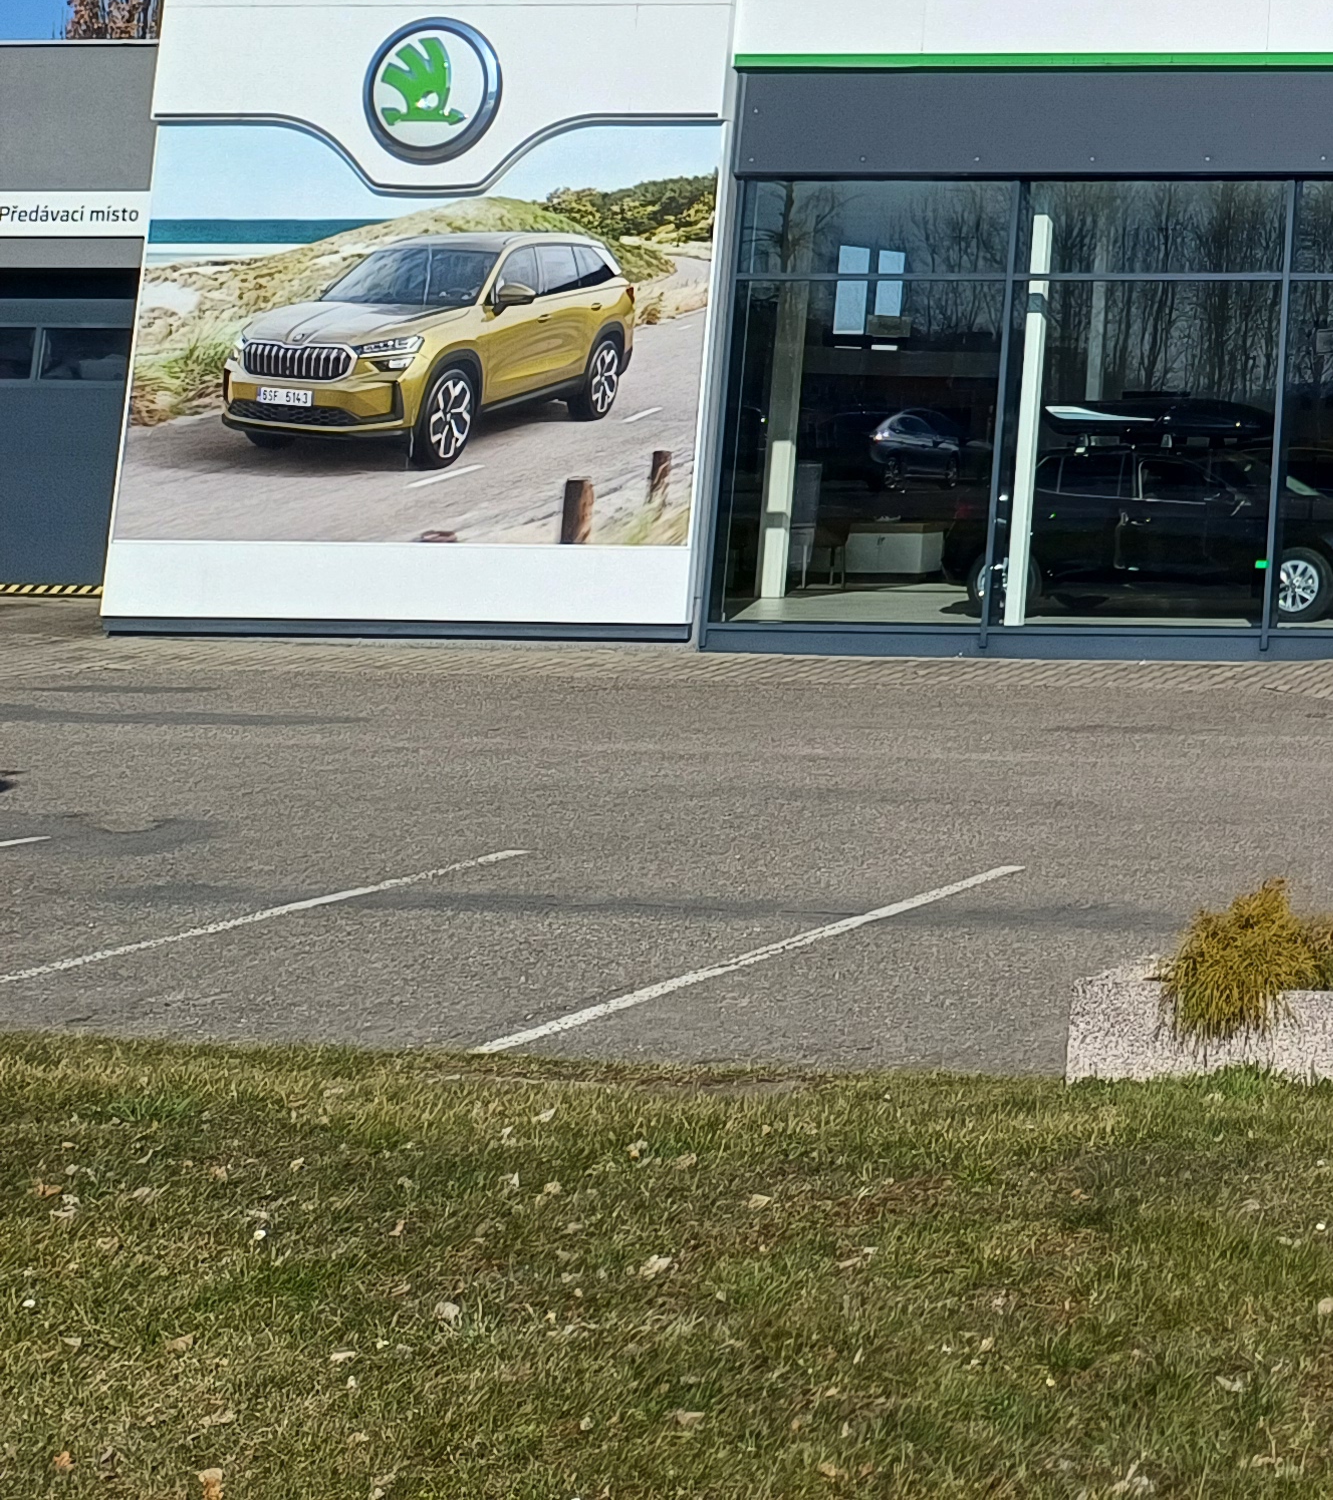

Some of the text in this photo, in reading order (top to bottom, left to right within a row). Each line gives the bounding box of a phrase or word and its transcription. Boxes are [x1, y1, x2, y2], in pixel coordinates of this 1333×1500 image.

[0, 204, 140, 222] Předávací místo
[285, 391, 308, 404] 5143
